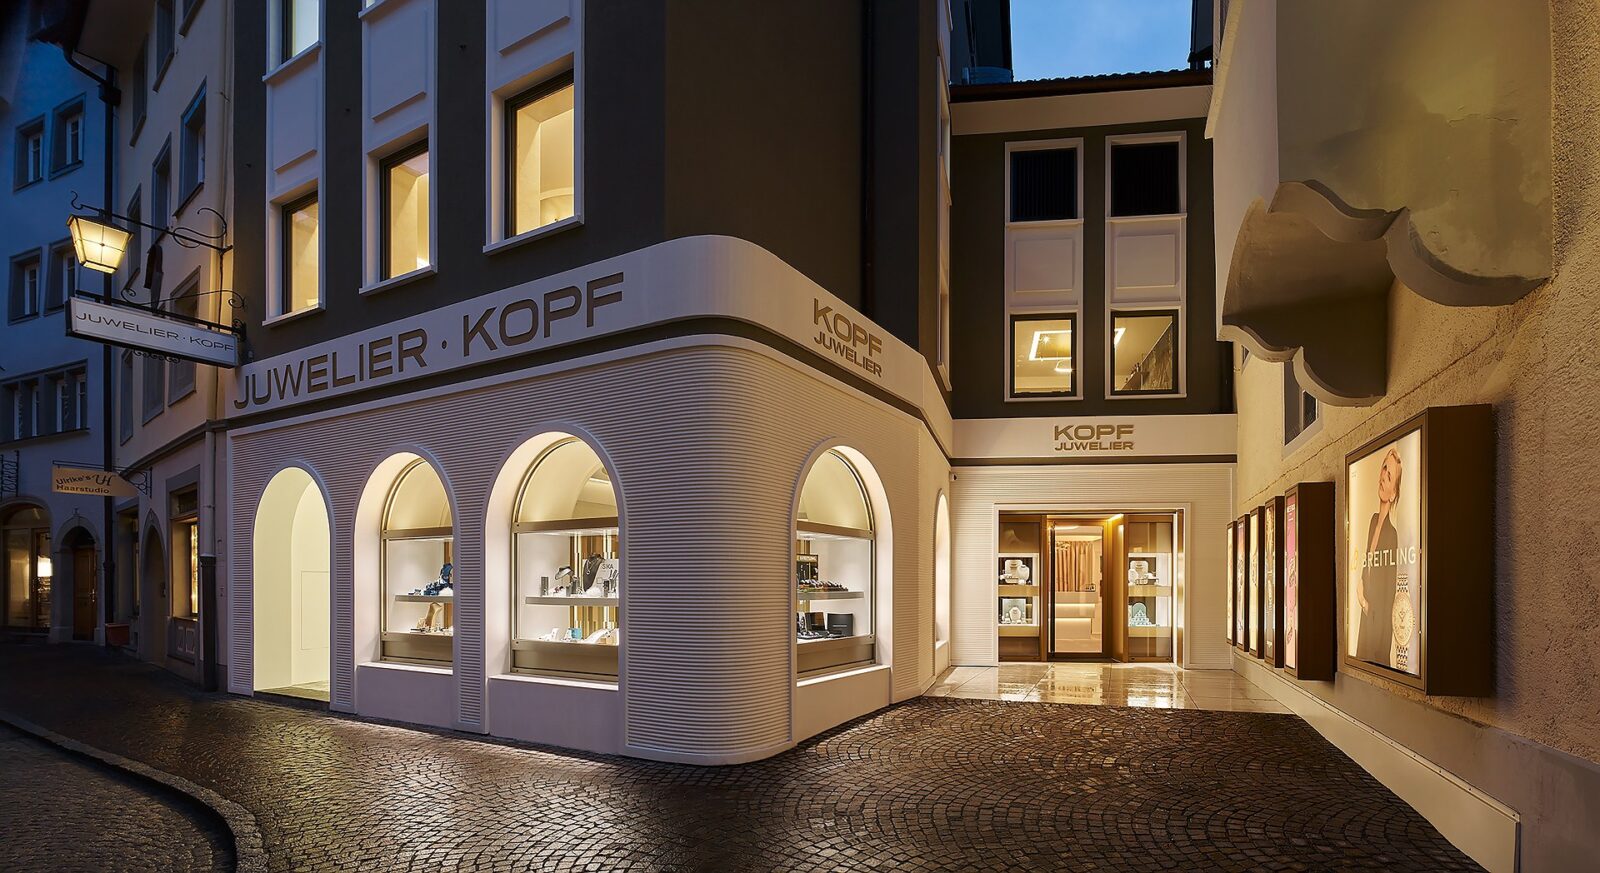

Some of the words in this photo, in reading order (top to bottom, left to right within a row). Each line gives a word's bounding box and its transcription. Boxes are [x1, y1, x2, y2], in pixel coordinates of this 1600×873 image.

[76, 313, 179, 340] JUWELIER
[189, 336, 234, 351] KOPF
[814, 298, 882, 357] KOPF
[234, 328, 428, 409] JUWELIER
[463, 272, 624, 356] KOPF
[814, 331, 882, 378] JUWELIER
[1054, 424, 1134, 441] KOPF
[1054, 441, 1134, 451] JUWELIER
[56, 474, 91, 485] Ulrike's
[56, 484, 110, 494] Haarstudio
[1362, 546, 1416, 568] BREITLING
